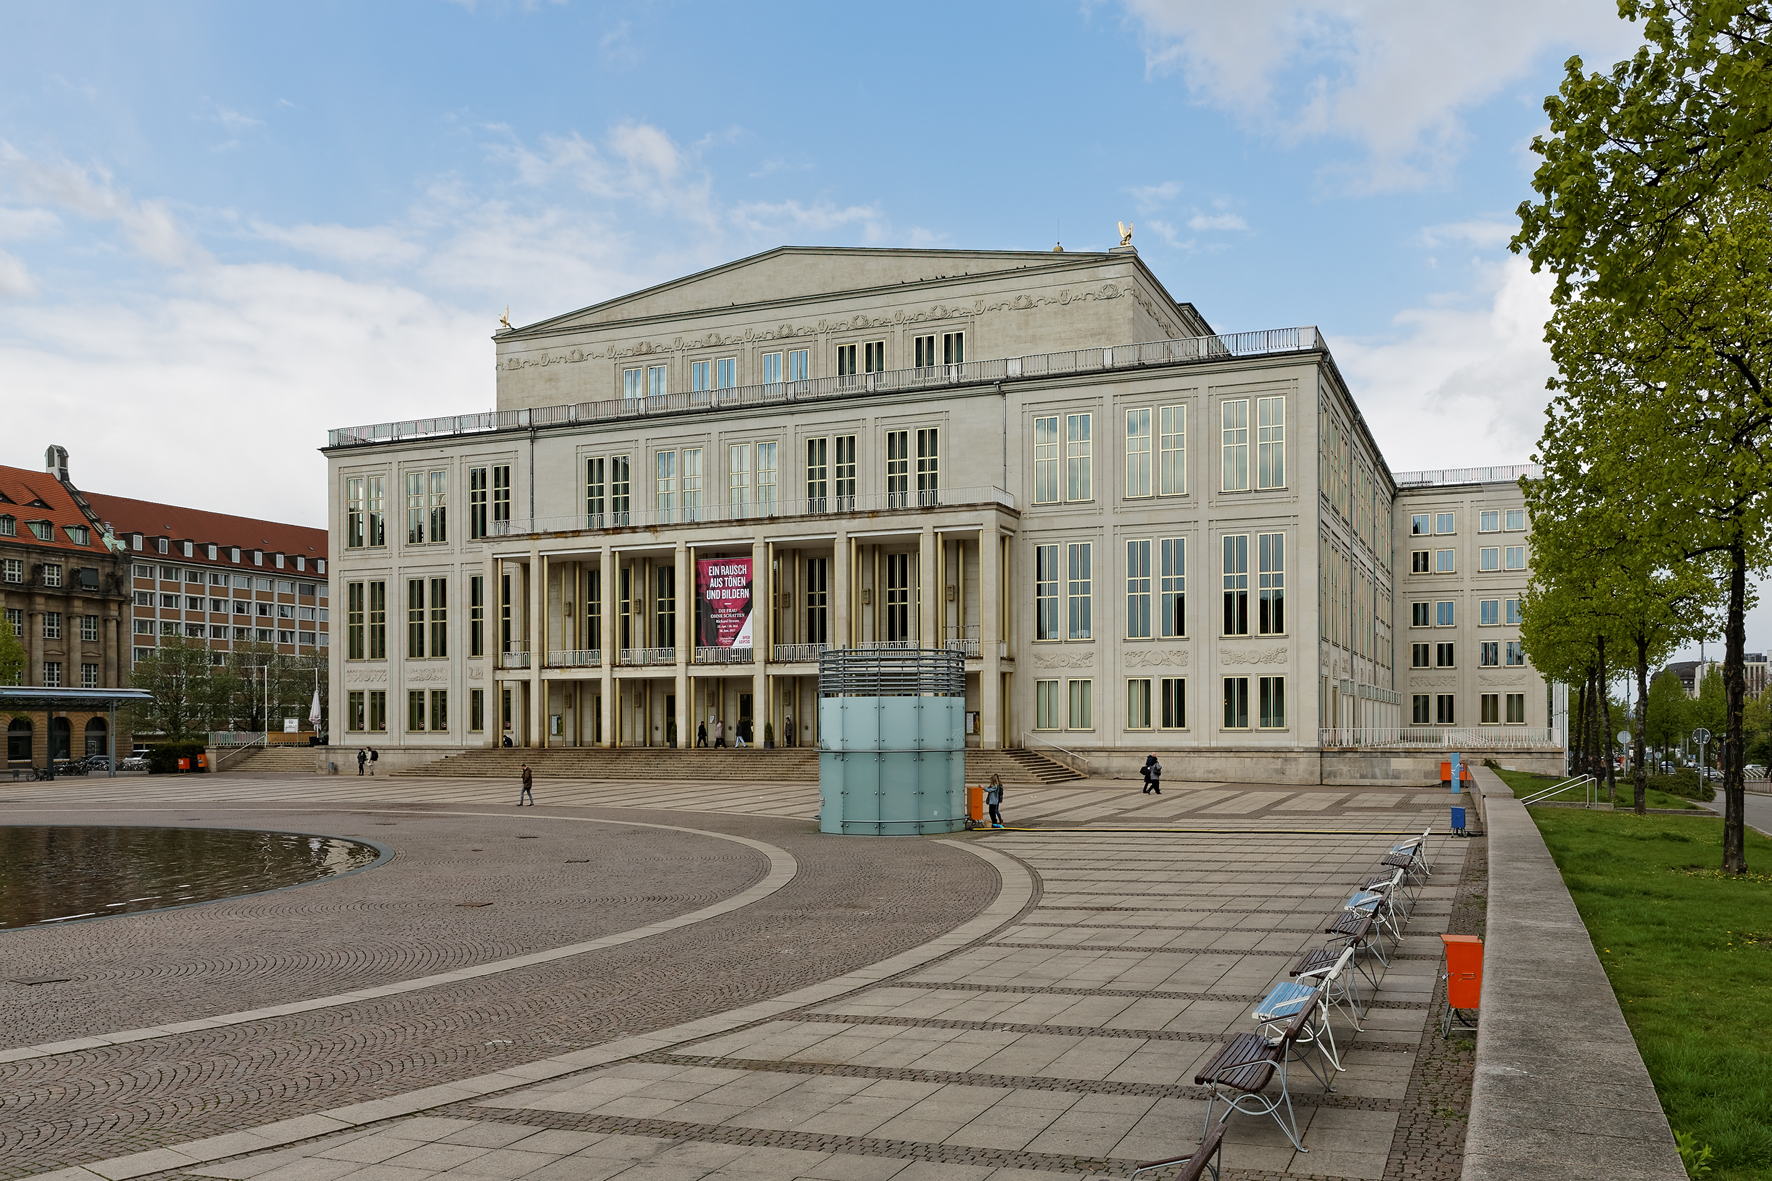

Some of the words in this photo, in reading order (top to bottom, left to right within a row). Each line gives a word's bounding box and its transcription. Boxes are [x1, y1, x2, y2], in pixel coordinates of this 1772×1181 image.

[708, 566, 720, 576] EIN
[721, 565, 747, 575] RAUSCH
[710, 578, 723, 588] AUS
[724, 576, 746, 587] TÖNEN
[706, 589, 720, 600] UND
[722, 588, 750, 599] BILDERN
